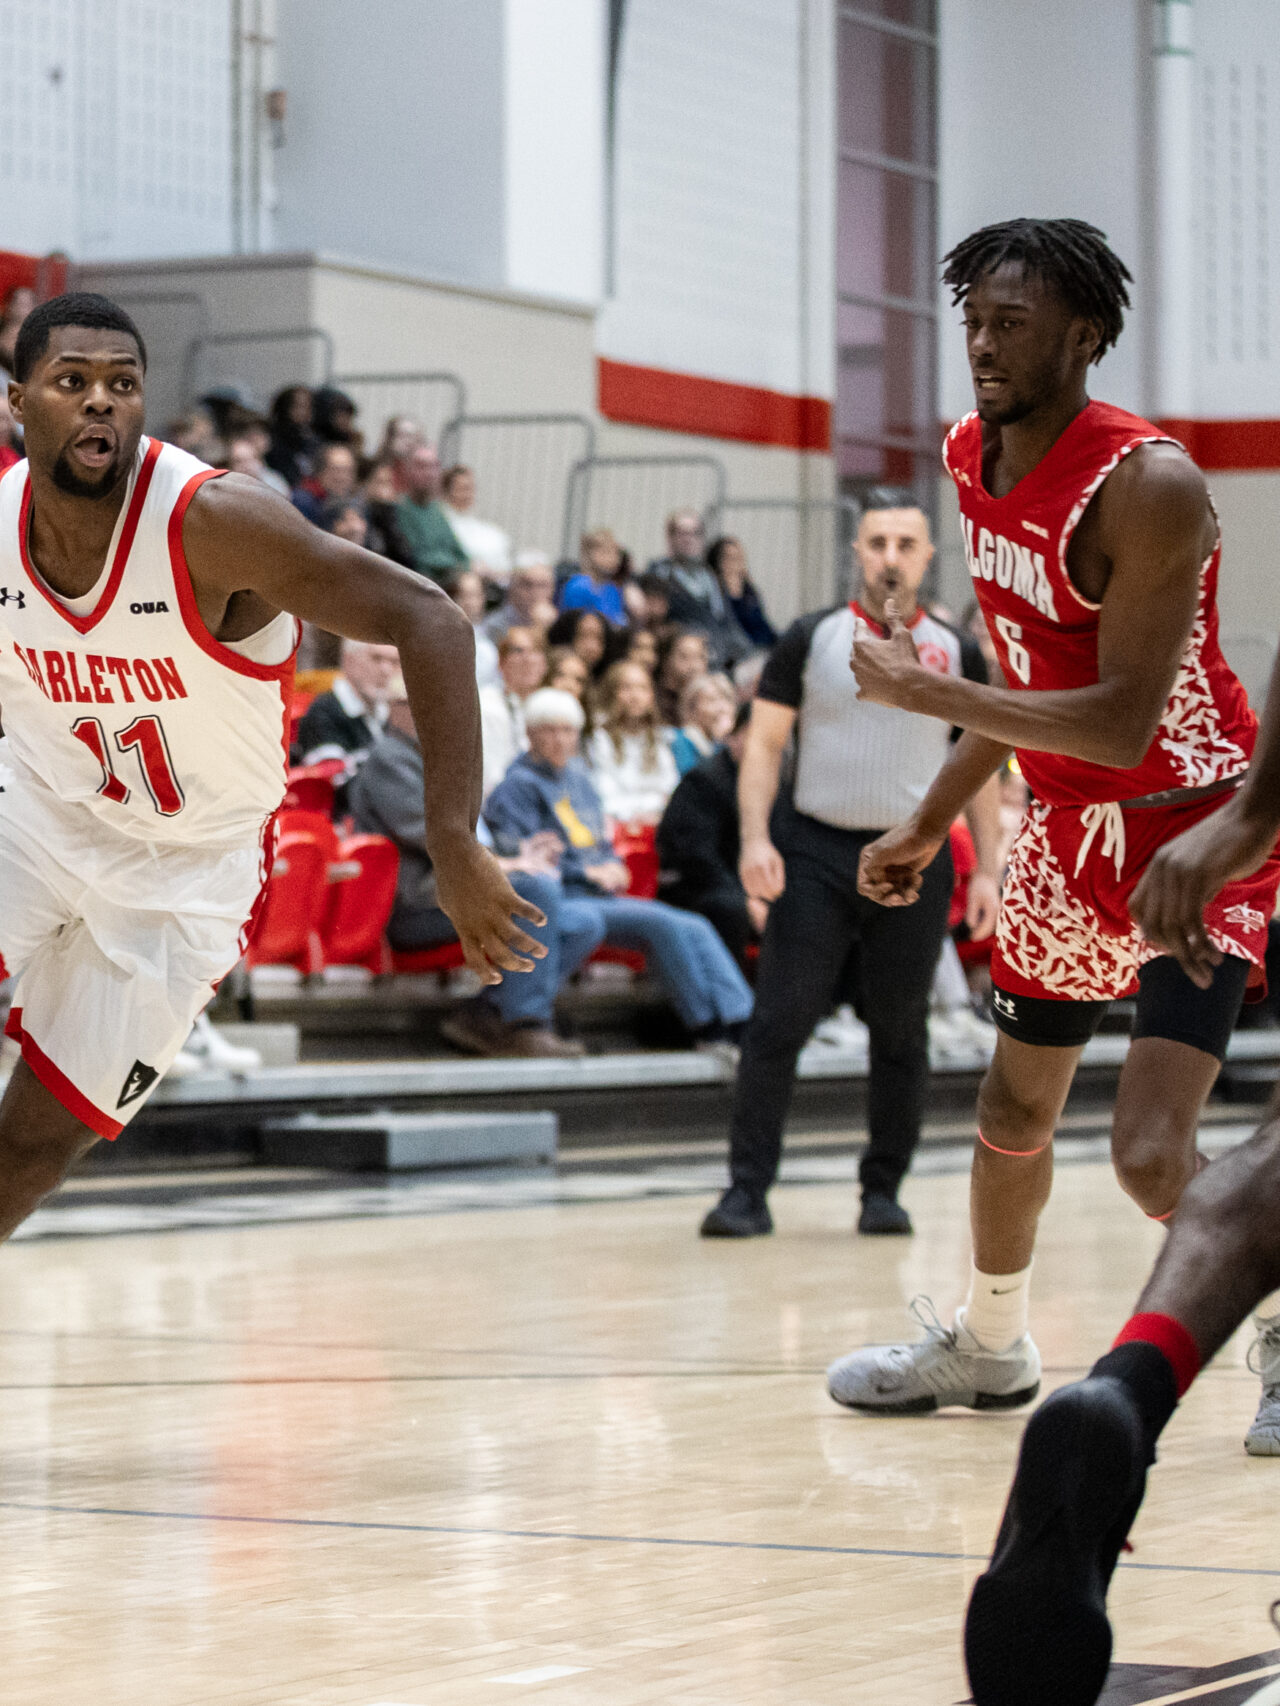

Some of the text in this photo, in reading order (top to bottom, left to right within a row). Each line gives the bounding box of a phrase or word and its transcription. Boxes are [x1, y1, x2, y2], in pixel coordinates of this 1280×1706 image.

[130, 601, 169, 614] OUA
[995, 614, 1030, 686] 6
[69, 714, 186, 818] 11
